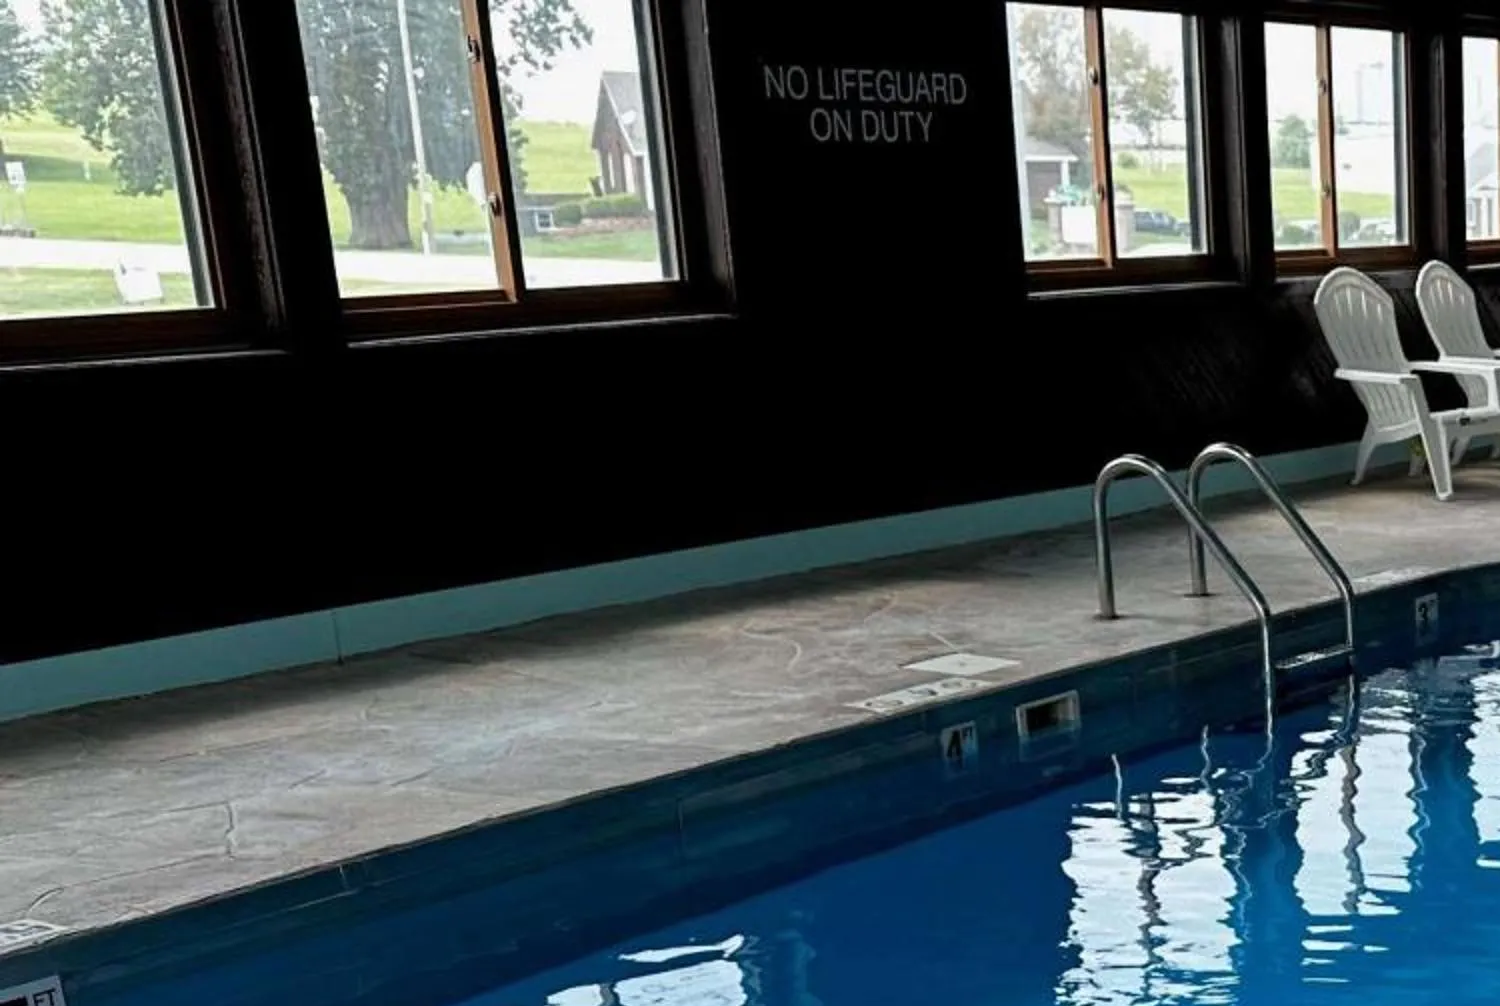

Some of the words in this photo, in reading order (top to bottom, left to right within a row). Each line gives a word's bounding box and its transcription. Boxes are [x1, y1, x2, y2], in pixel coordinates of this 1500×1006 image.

[763, 65, 809, 100] NO
[817, 67, 967, 105] LIFEGUARD
[810, 107, 853, 142] ON
[861, 110, 933, 143] DUTY
